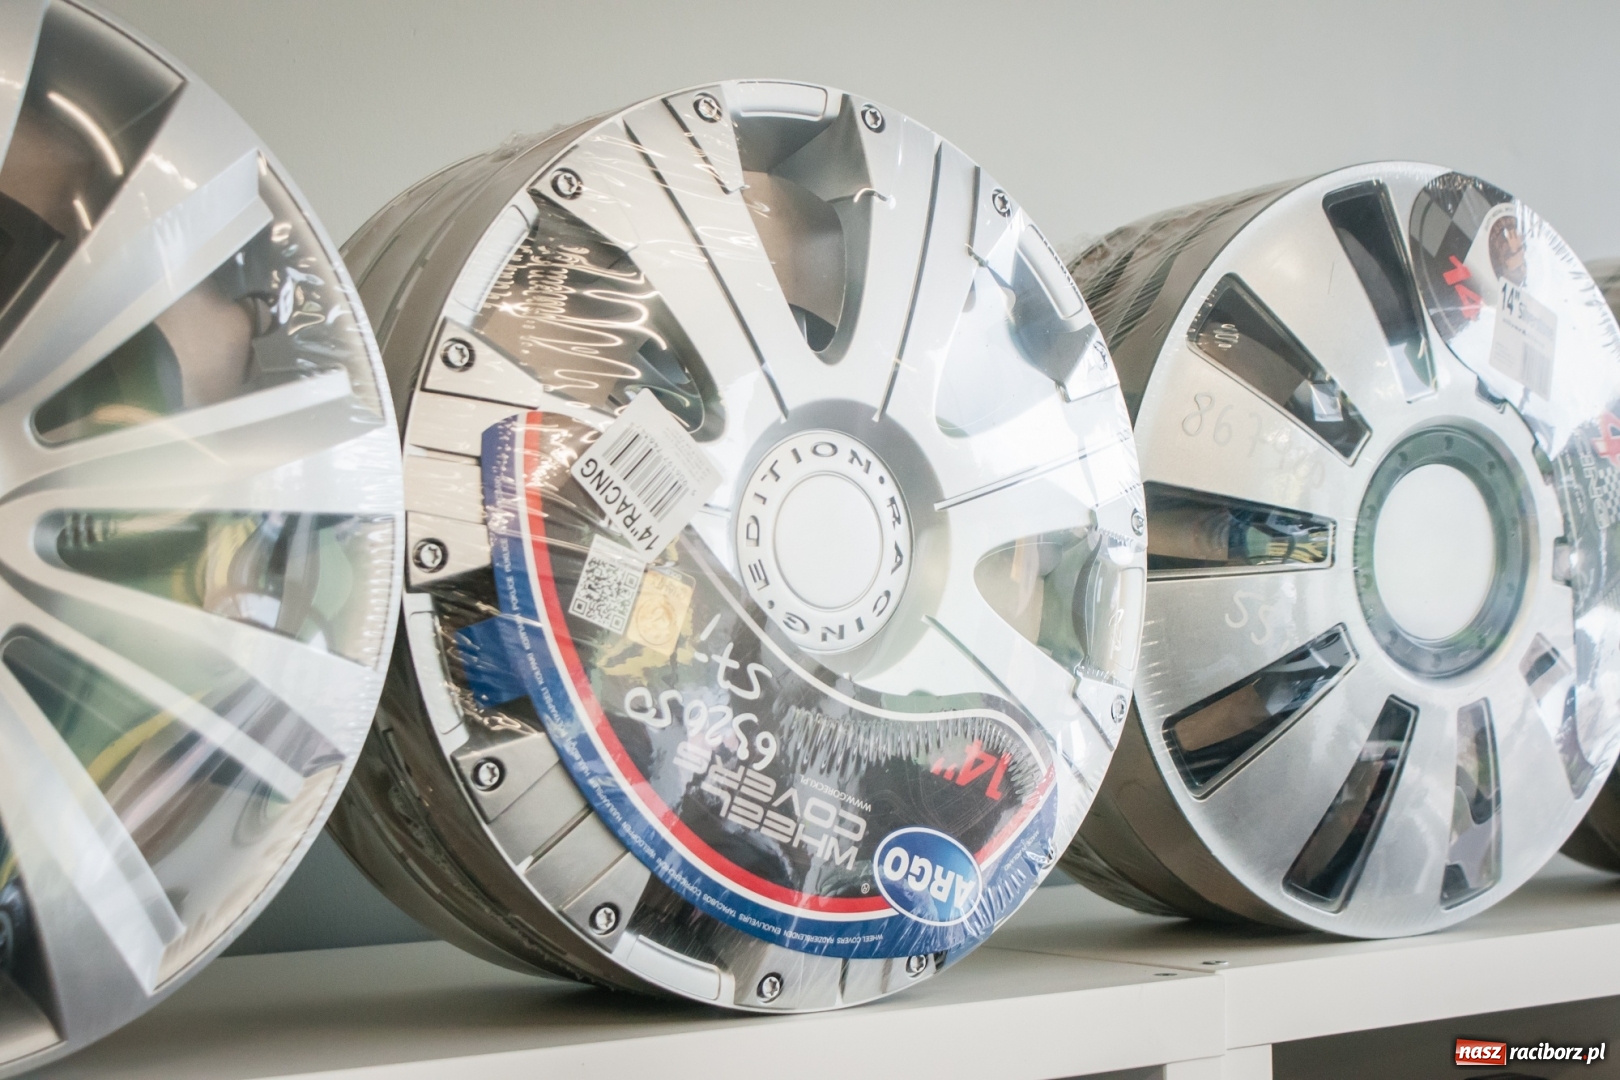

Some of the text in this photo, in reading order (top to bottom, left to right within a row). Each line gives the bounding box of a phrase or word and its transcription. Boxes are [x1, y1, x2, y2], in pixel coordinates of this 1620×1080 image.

[746, 441, 903, 642] RACING EDITION
[673, 741, 867, 842] COVERS
[701, 778, 859, 870] WHEEL
[883, 846, 978, 909] ARGO
[737, 912, 781, 935] ENJOLIVEURS
[836, 936, 861, 944] COVERS
[861, 933, 883, 944] WHEEL
